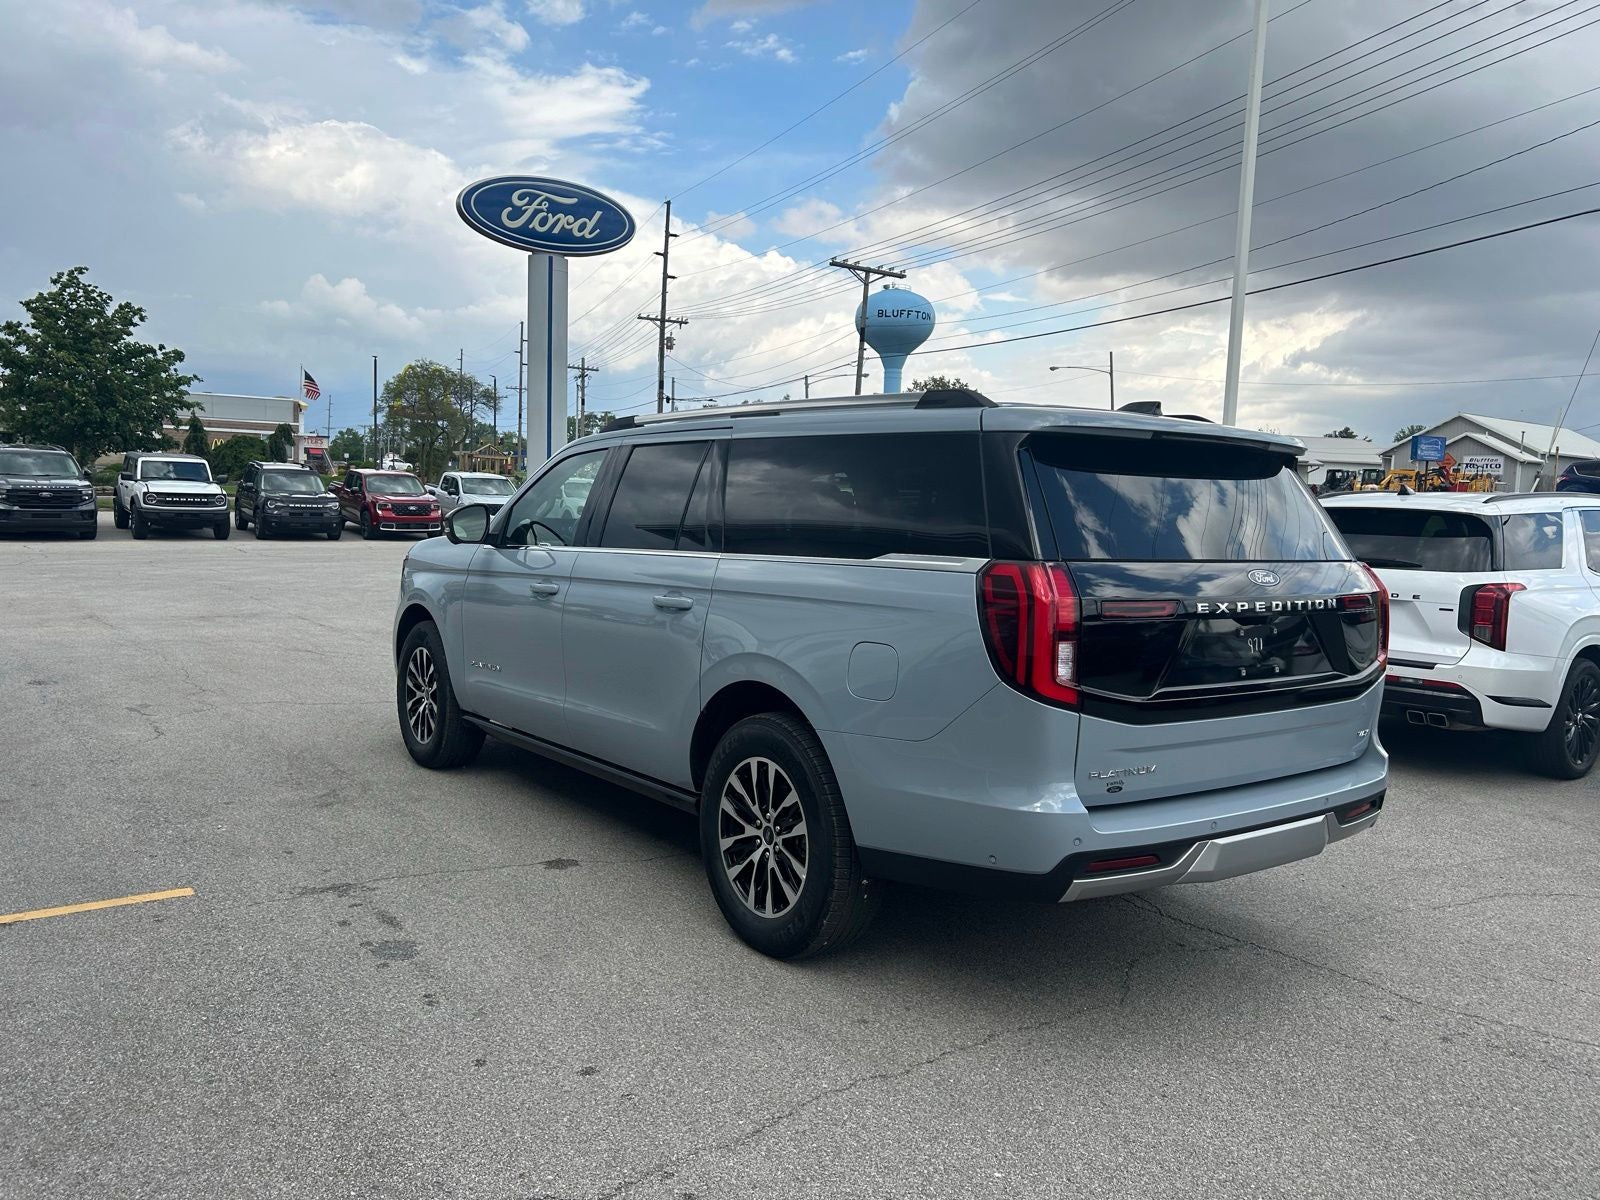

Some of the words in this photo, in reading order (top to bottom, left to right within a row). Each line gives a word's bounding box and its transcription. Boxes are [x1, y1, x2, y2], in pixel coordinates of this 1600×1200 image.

[501, 189, 602, 239] Ford
[877, 308, 932, 321] BLUFFTON
[1254, 572, 1276, 583] Ford
[1196, 599, 1337, 614] EXPEDITION
[1089, 764, 1157, 780] PLATINUM
